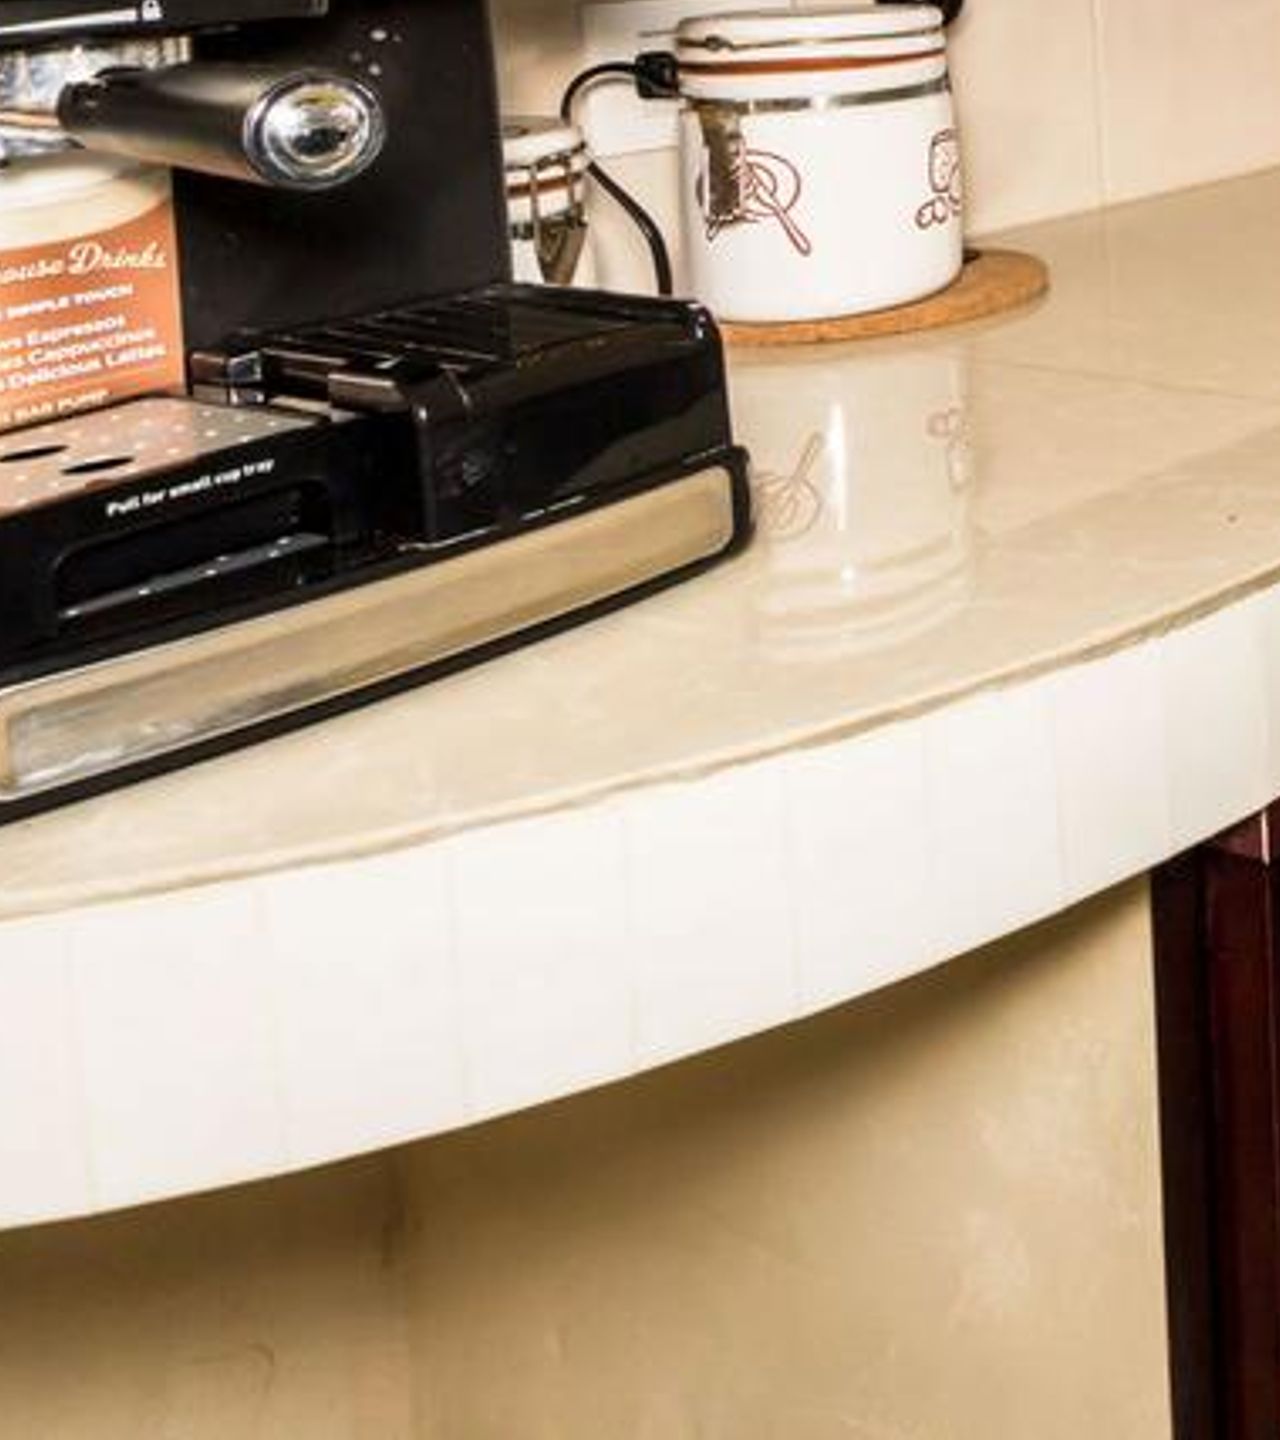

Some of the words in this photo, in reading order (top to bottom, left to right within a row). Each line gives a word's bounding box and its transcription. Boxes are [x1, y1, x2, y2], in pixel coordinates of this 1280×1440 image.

[68, 240, 167, 276] Drinks
[106, 494, 141, 517] Pull
[142, 489, 168, 506] for
[168, 474, 212, 498] small
[213, 468, 241, 486] cup
[242, 458, 275, 478] tray
